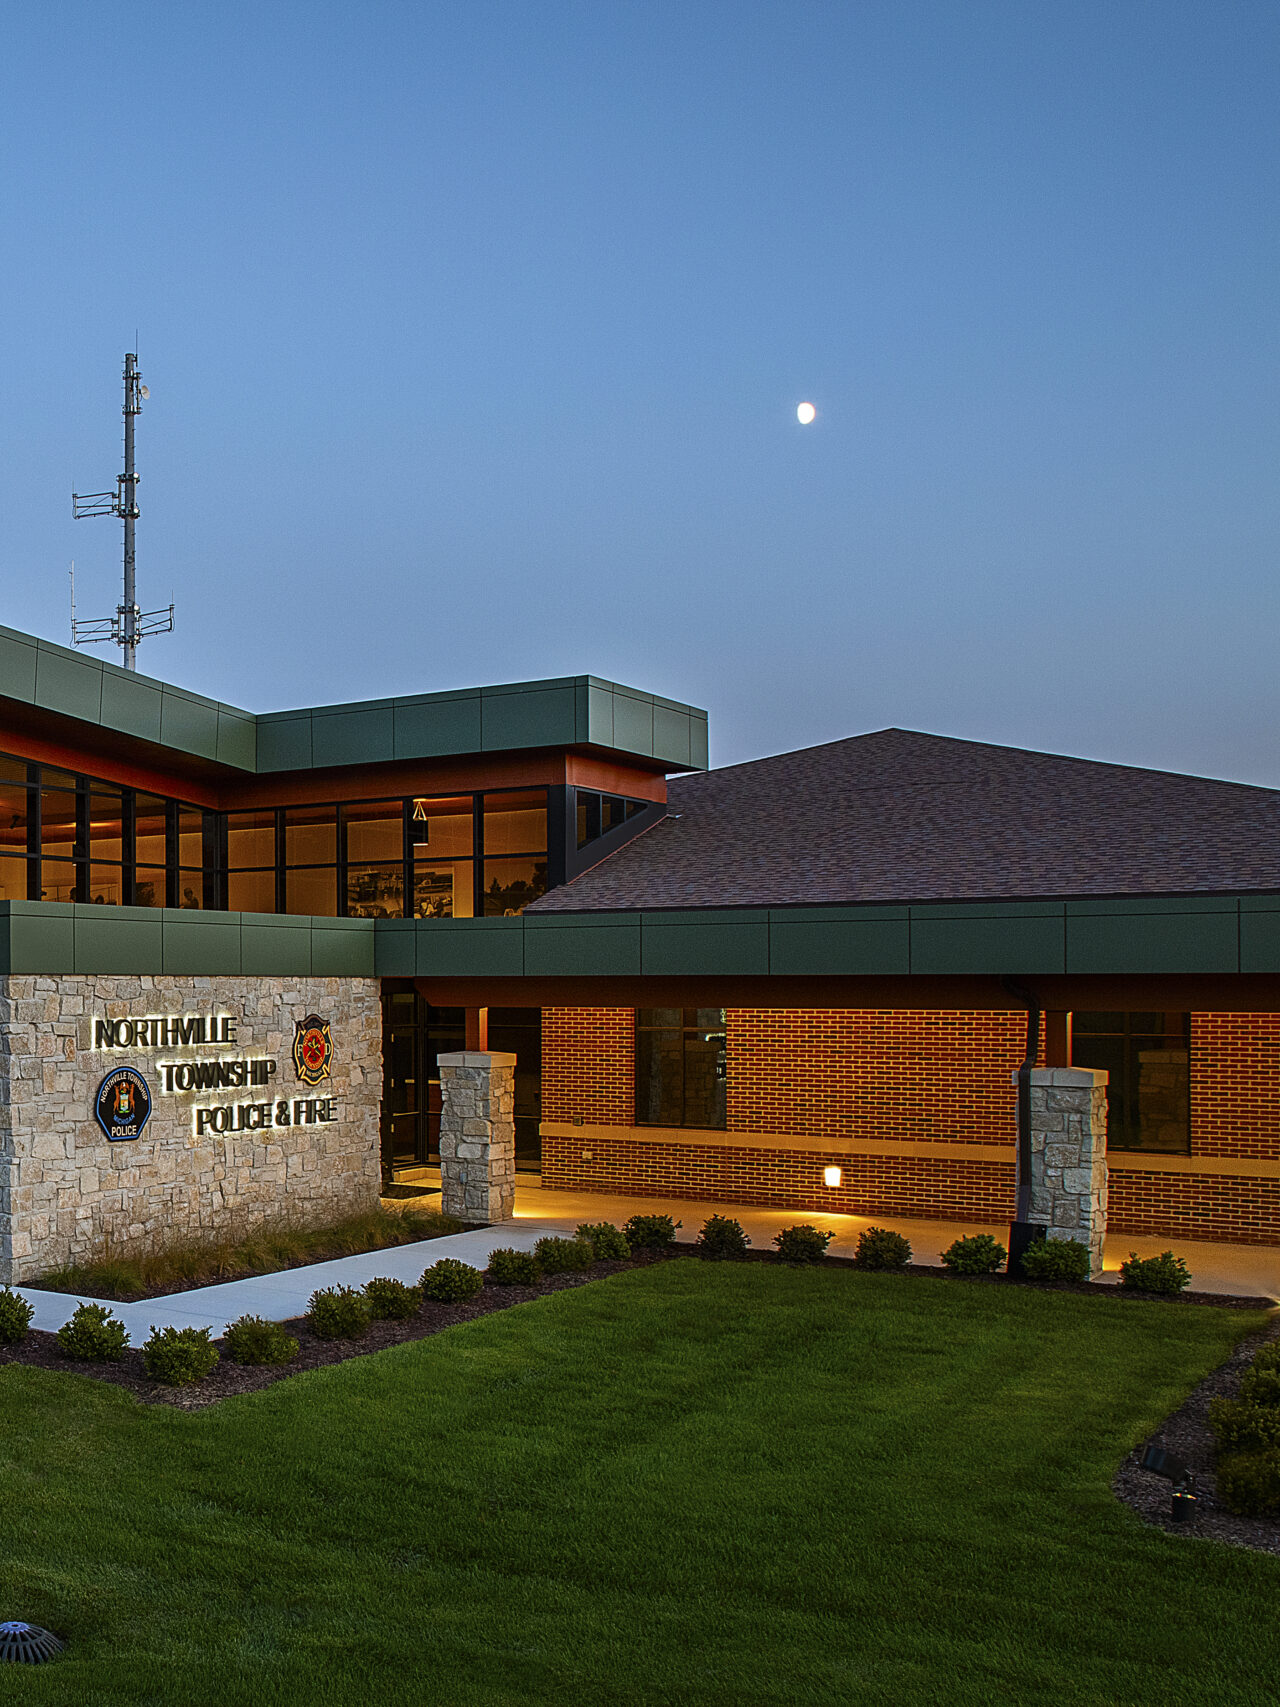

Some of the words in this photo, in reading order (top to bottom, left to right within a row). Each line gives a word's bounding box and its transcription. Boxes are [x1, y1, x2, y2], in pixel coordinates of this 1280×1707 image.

[95, 1017, 237, 1048] NORTHVILLE
[100, 1071, 127, 1103] NORTHVILLE
[127, 1072, 148, 1101] TOWNSHIP
[160, 1059, 276, 1092] TOWNSHIP
[111, 1125, 137, 1137] POLICE
[196, 1102, 272, 1135] POLICE
[275, 1100, 289, 1126] &
[293, 1097, 338, 1125] FIRE
